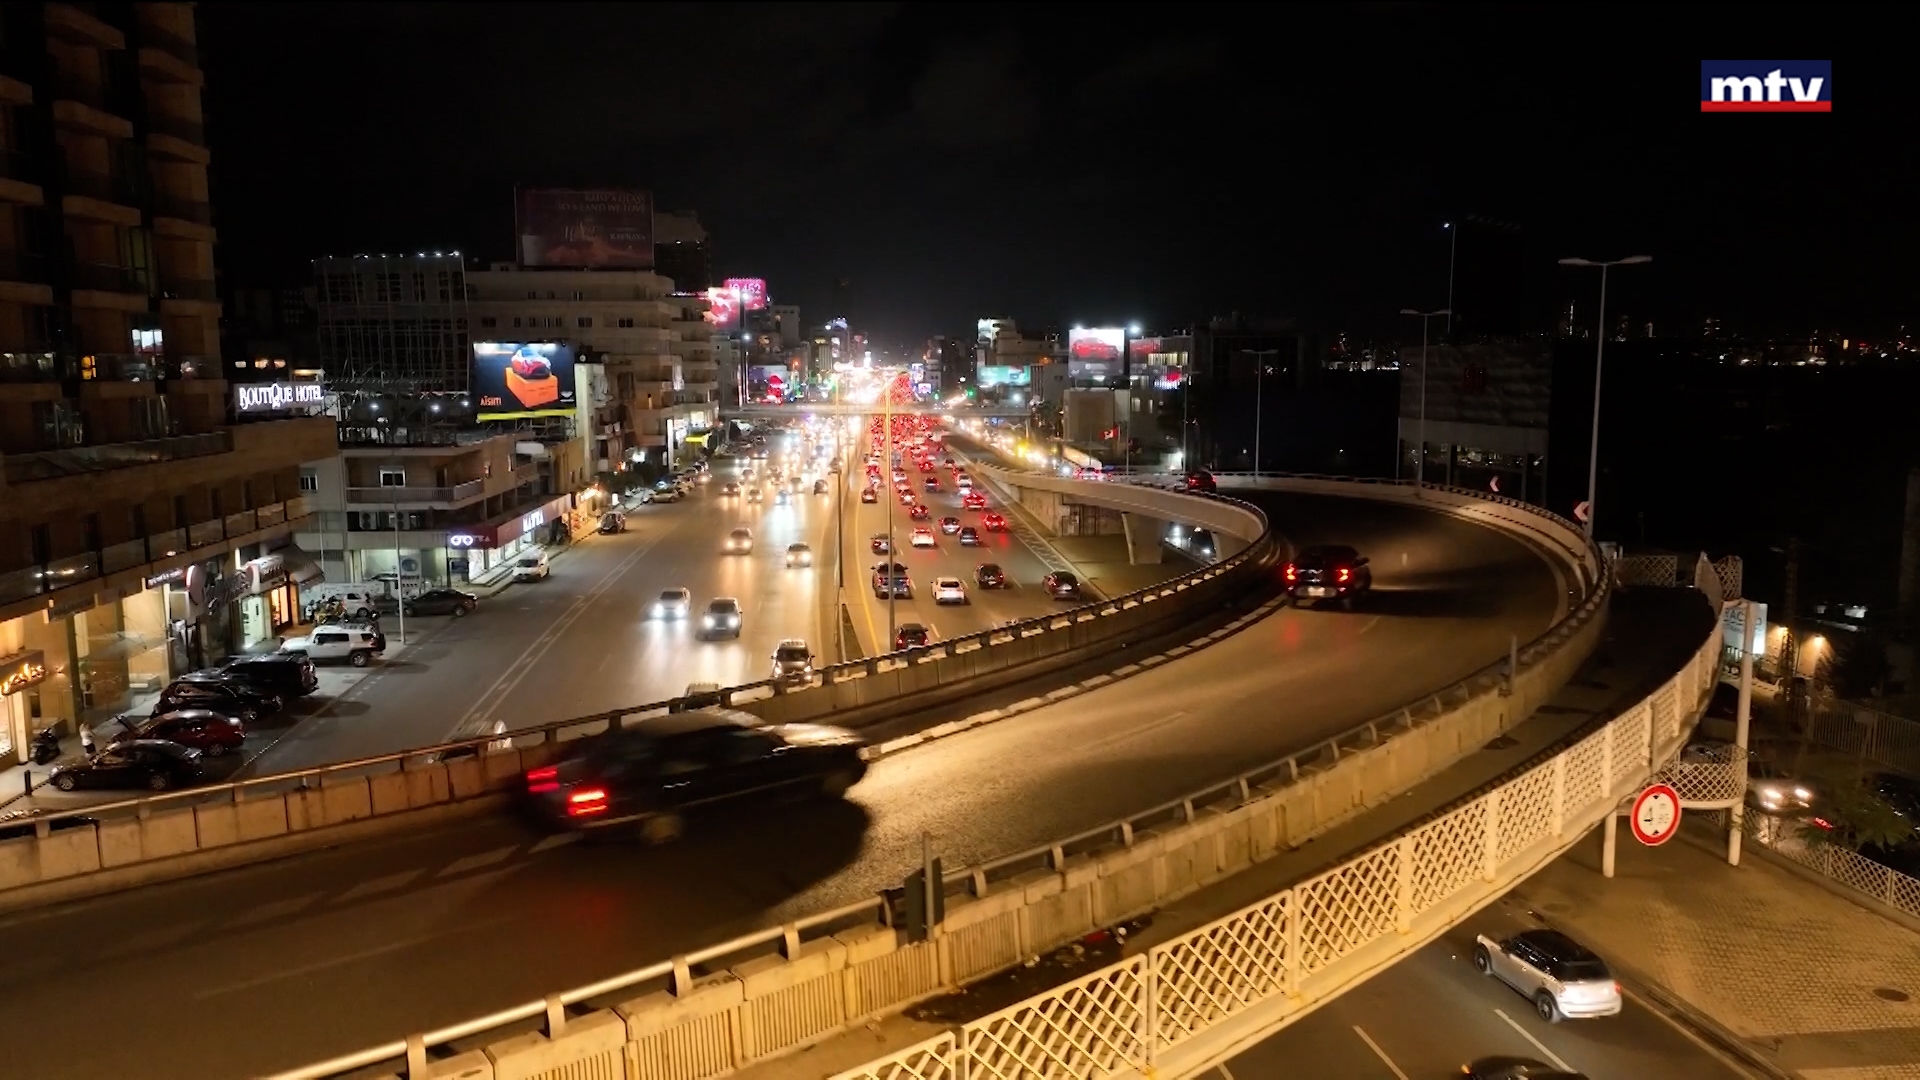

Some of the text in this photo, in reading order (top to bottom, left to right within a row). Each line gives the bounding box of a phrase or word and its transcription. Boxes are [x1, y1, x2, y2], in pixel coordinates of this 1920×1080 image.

[580, 203, 606, 212] LAND
[238, 383, 325, 410] BOUTIQUE HOTEL
